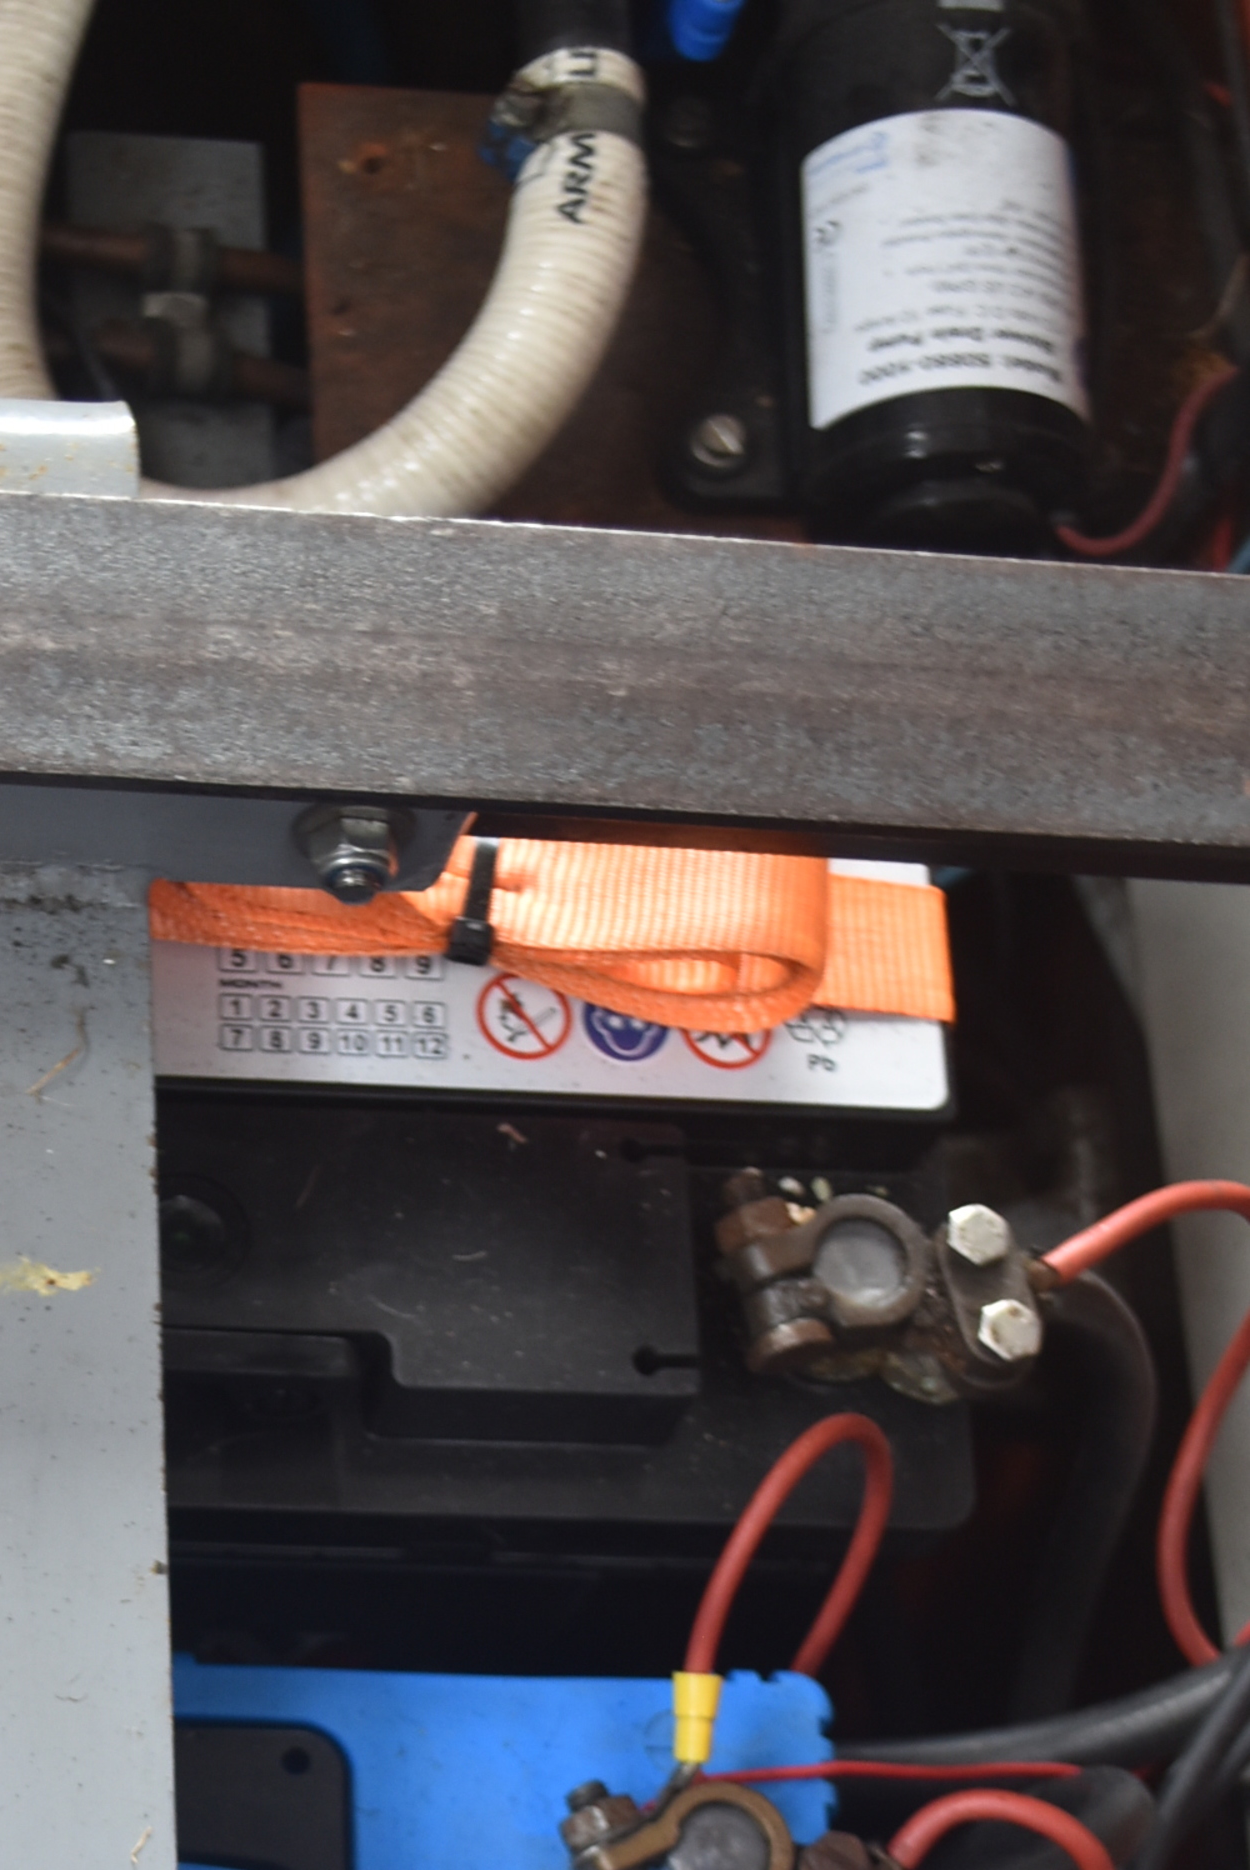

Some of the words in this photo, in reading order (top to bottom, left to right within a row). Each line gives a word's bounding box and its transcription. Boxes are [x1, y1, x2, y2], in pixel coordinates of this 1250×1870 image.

[231, 1000, 242, 1015] 1
[268, 1000, 282, 1018] 2
[308, 1001, 321, 1019] 3
[346, 1003, 359, 1020] 4
[384, 1004, 398, 1022] 5
[422, 1006, 437, 1024] 6
[229, 1028, 244, 1047] 7
[268, 1029, 284, 1049] 8
[308, 1032, 322, 1050] 9
[339, 1034, 367, 1051] 10
[418, 1038, 442, 1055] 12
